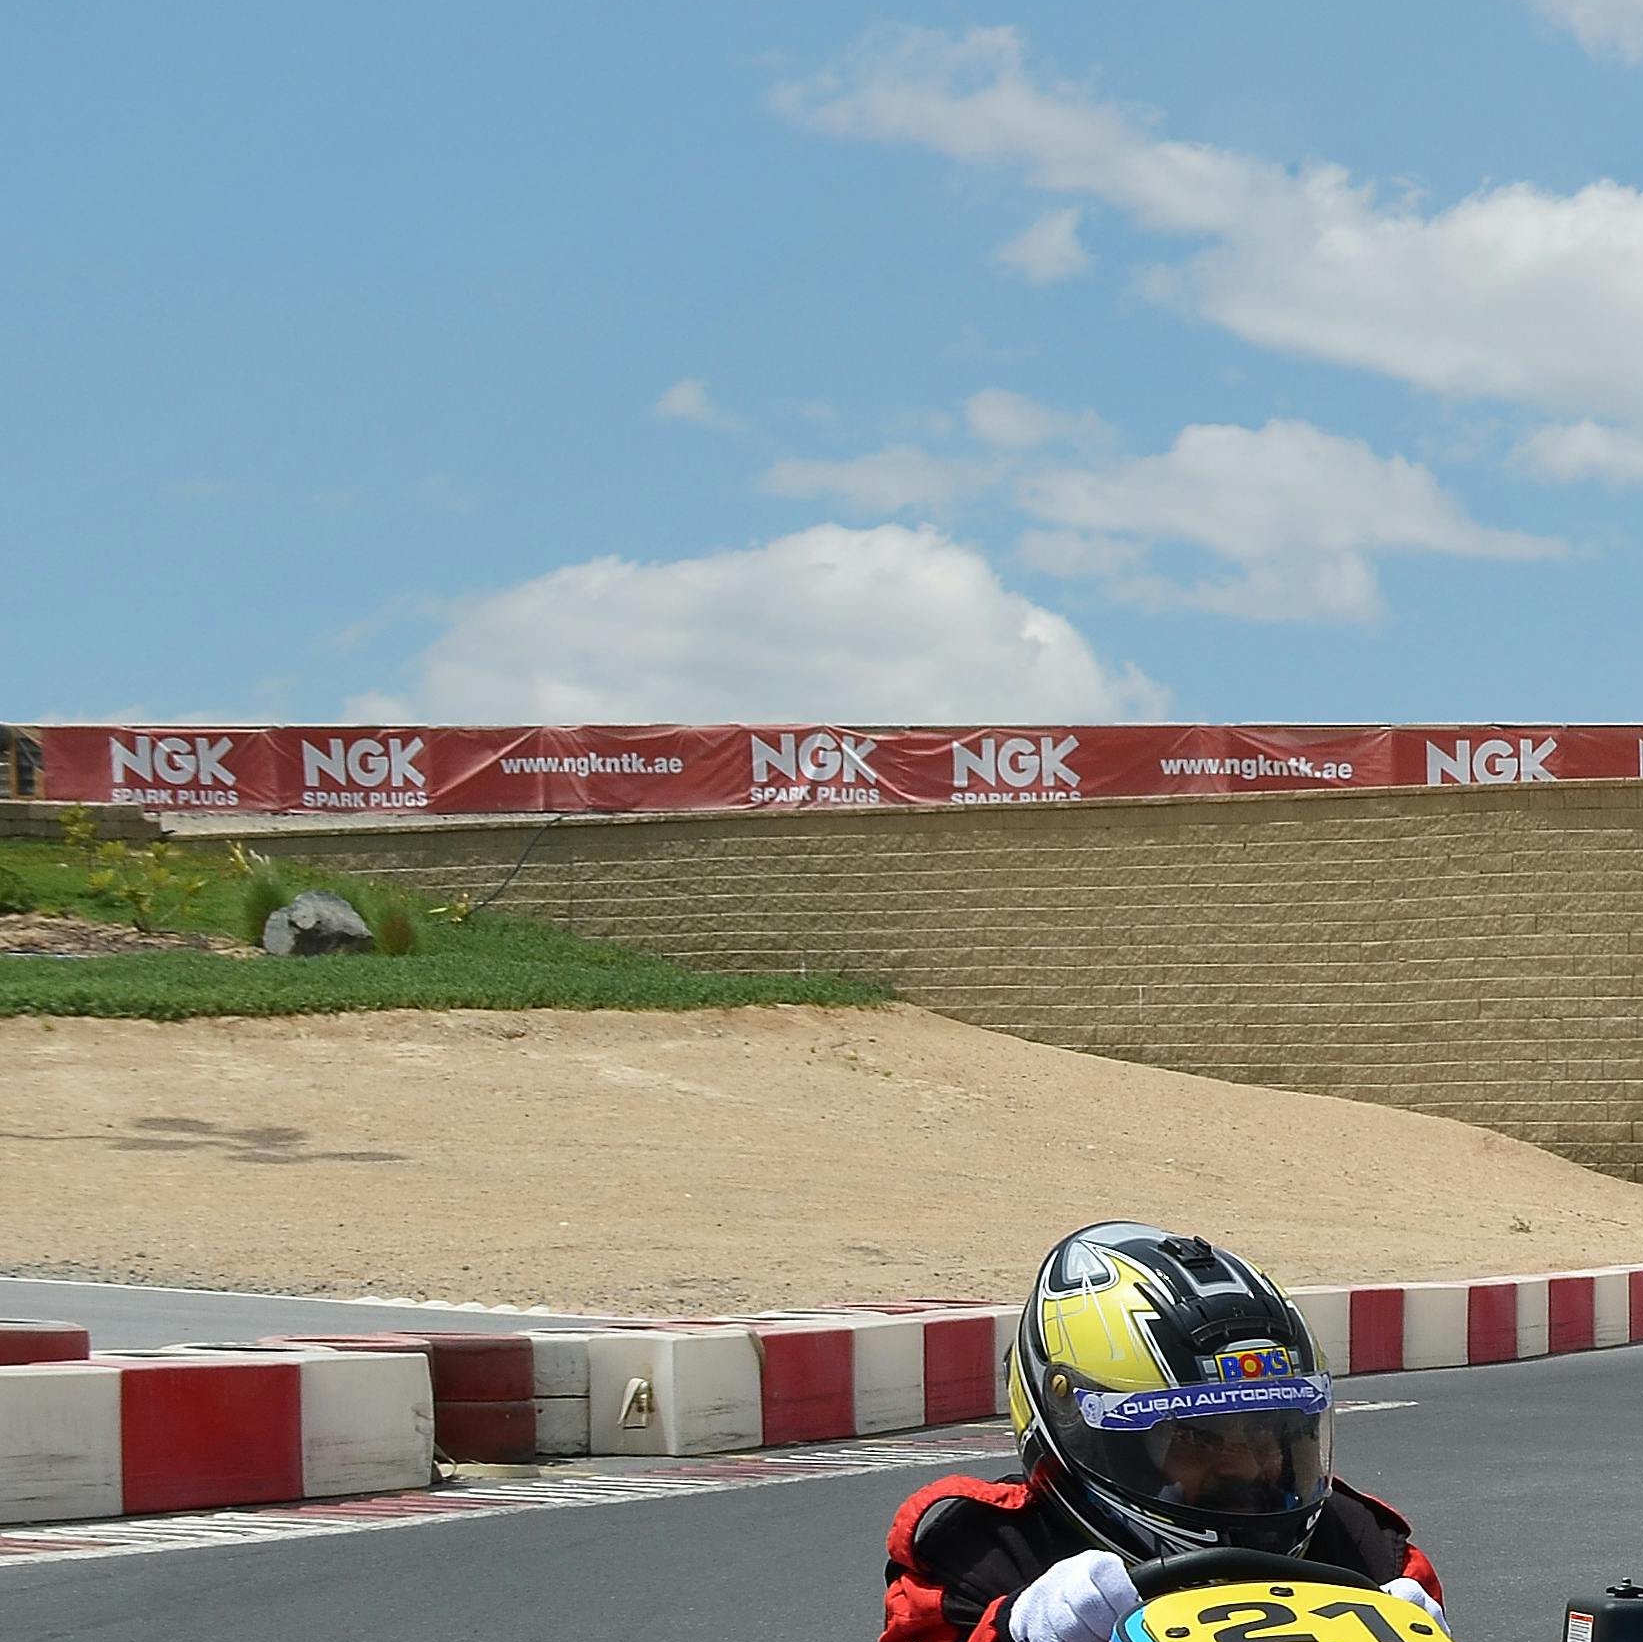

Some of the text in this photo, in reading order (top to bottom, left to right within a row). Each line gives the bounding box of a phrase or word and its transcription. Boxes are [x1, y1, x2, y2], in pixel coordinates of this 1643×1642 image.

[110, 736, 236, 786] NGK
[302, 736, 426, 787] NGK
[500, 750, 683, 775] www.ngkntk.ae
[750, 732, 878, 782] NGK
[952, 734, 1081, 788] NGK
[1160, 753, 1353, 781] www.ngkntk.ae
[1426, 735, 1557, 786] NGK
[112, 788, 239, 806] SPARK PLUGS
[303, 791, 427, 808] SPARK PLUGS
[750, 784, 880, 804] SPARK PLUGS
[950, 790, 1082, 805] SPARK PLUGS
[1123, 1386, 1316, 1415] DUBAI AUTODROME
